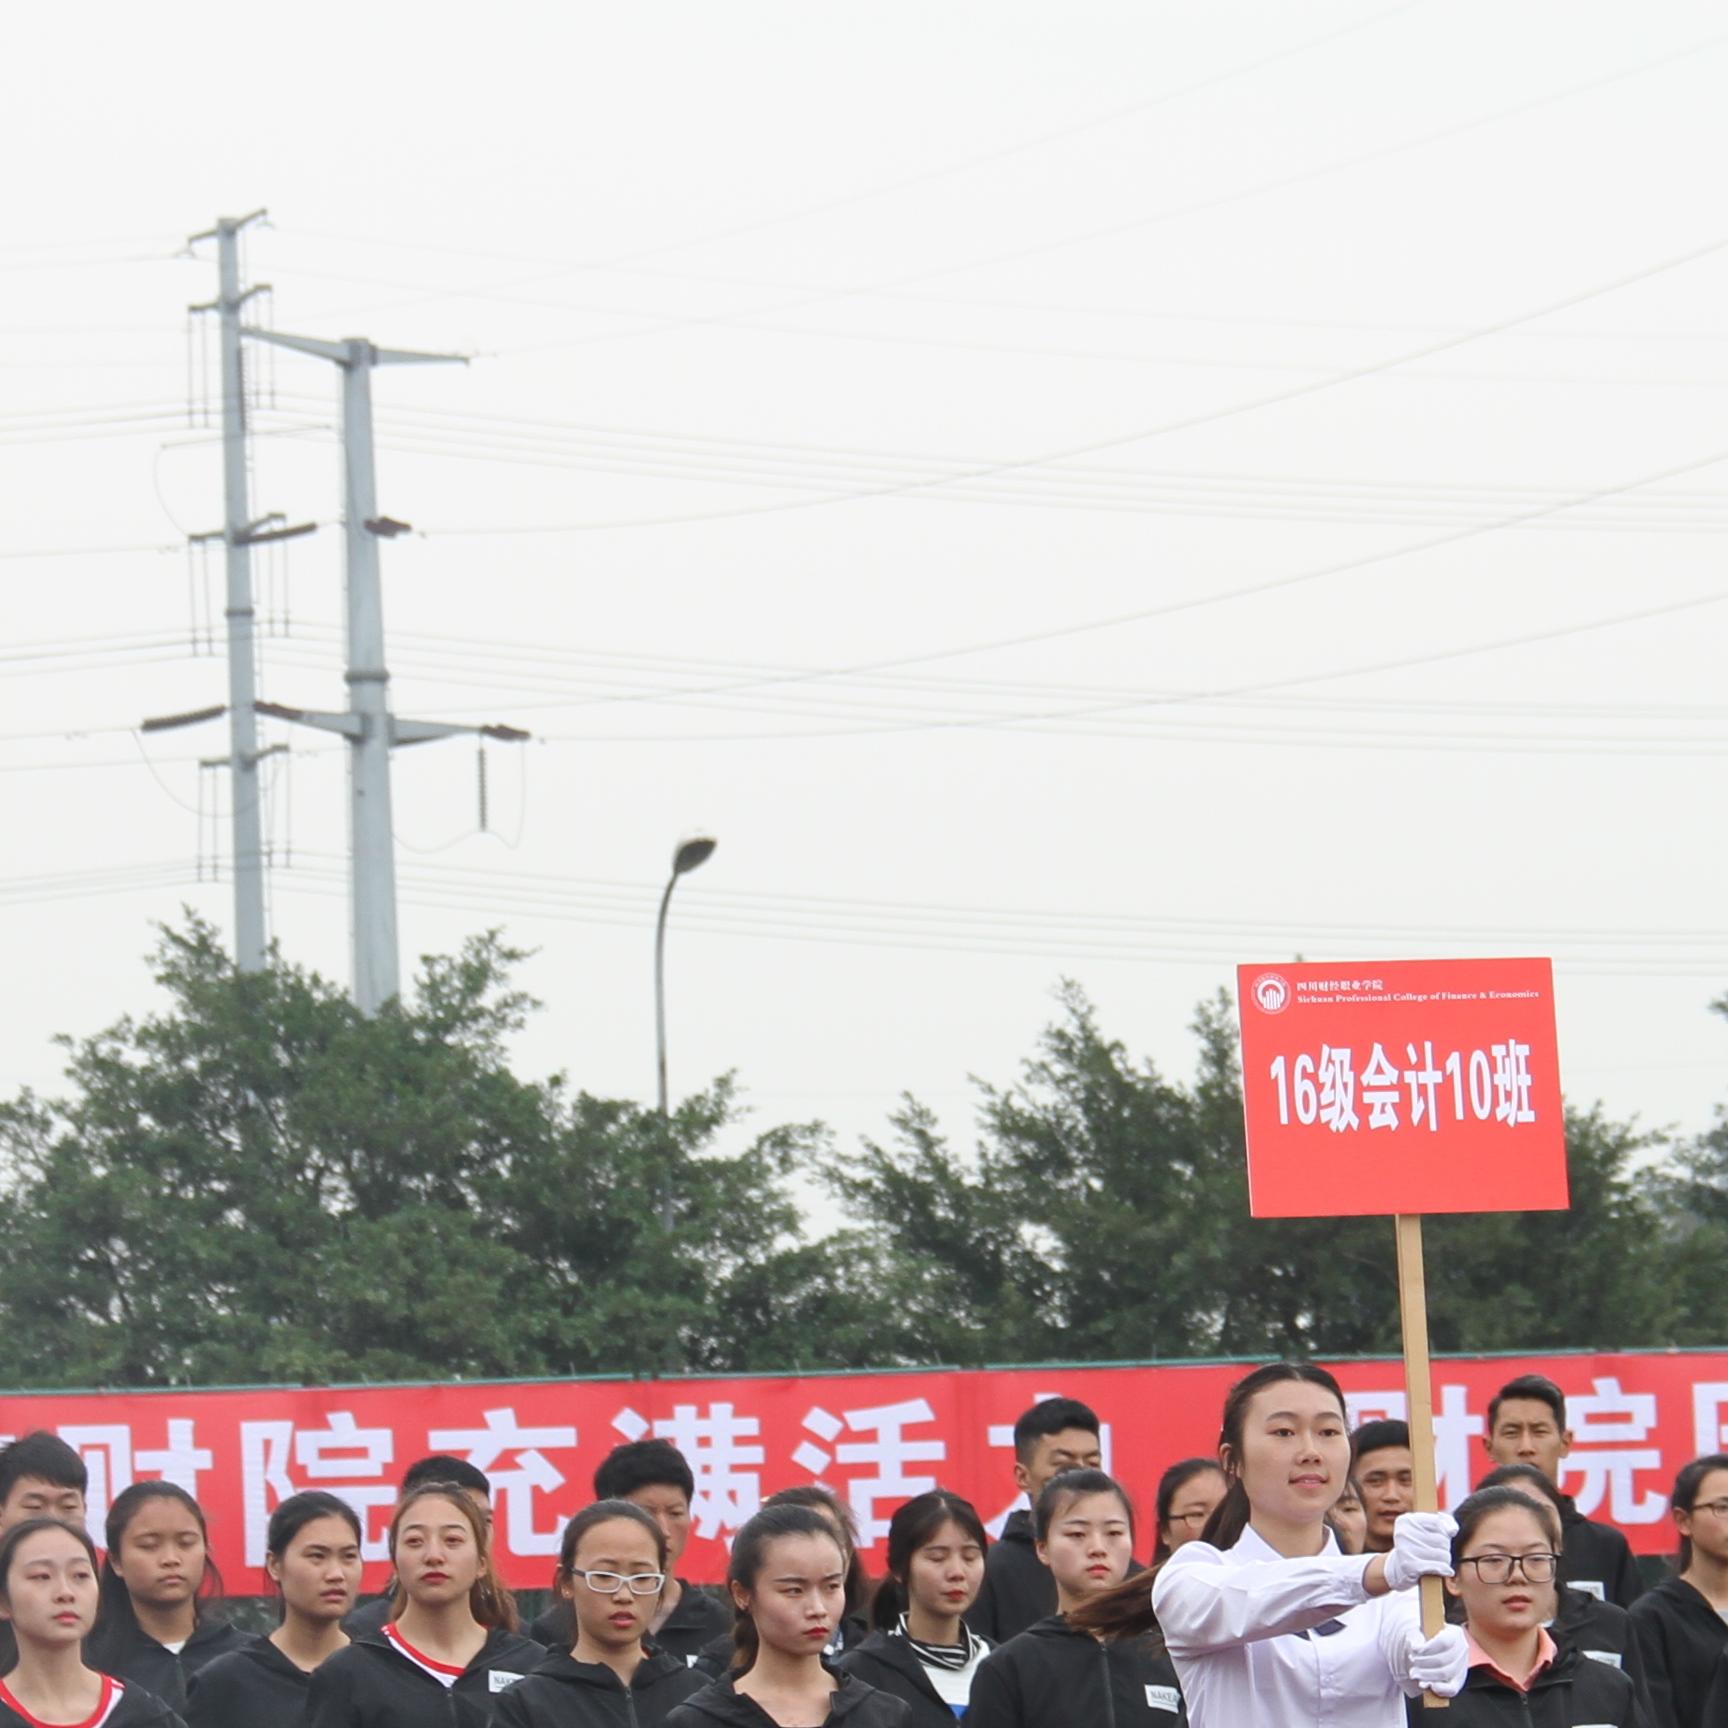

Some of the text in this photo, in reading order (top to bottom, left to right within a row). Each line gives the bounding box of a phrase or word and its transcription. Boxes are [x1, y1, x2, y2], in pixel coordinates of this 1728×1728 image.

[1297, 990, 1540, 1004] Sichuan Professional College of Finance & Economics
[1270, 1038, 1536, 1133] 16级会计10班
